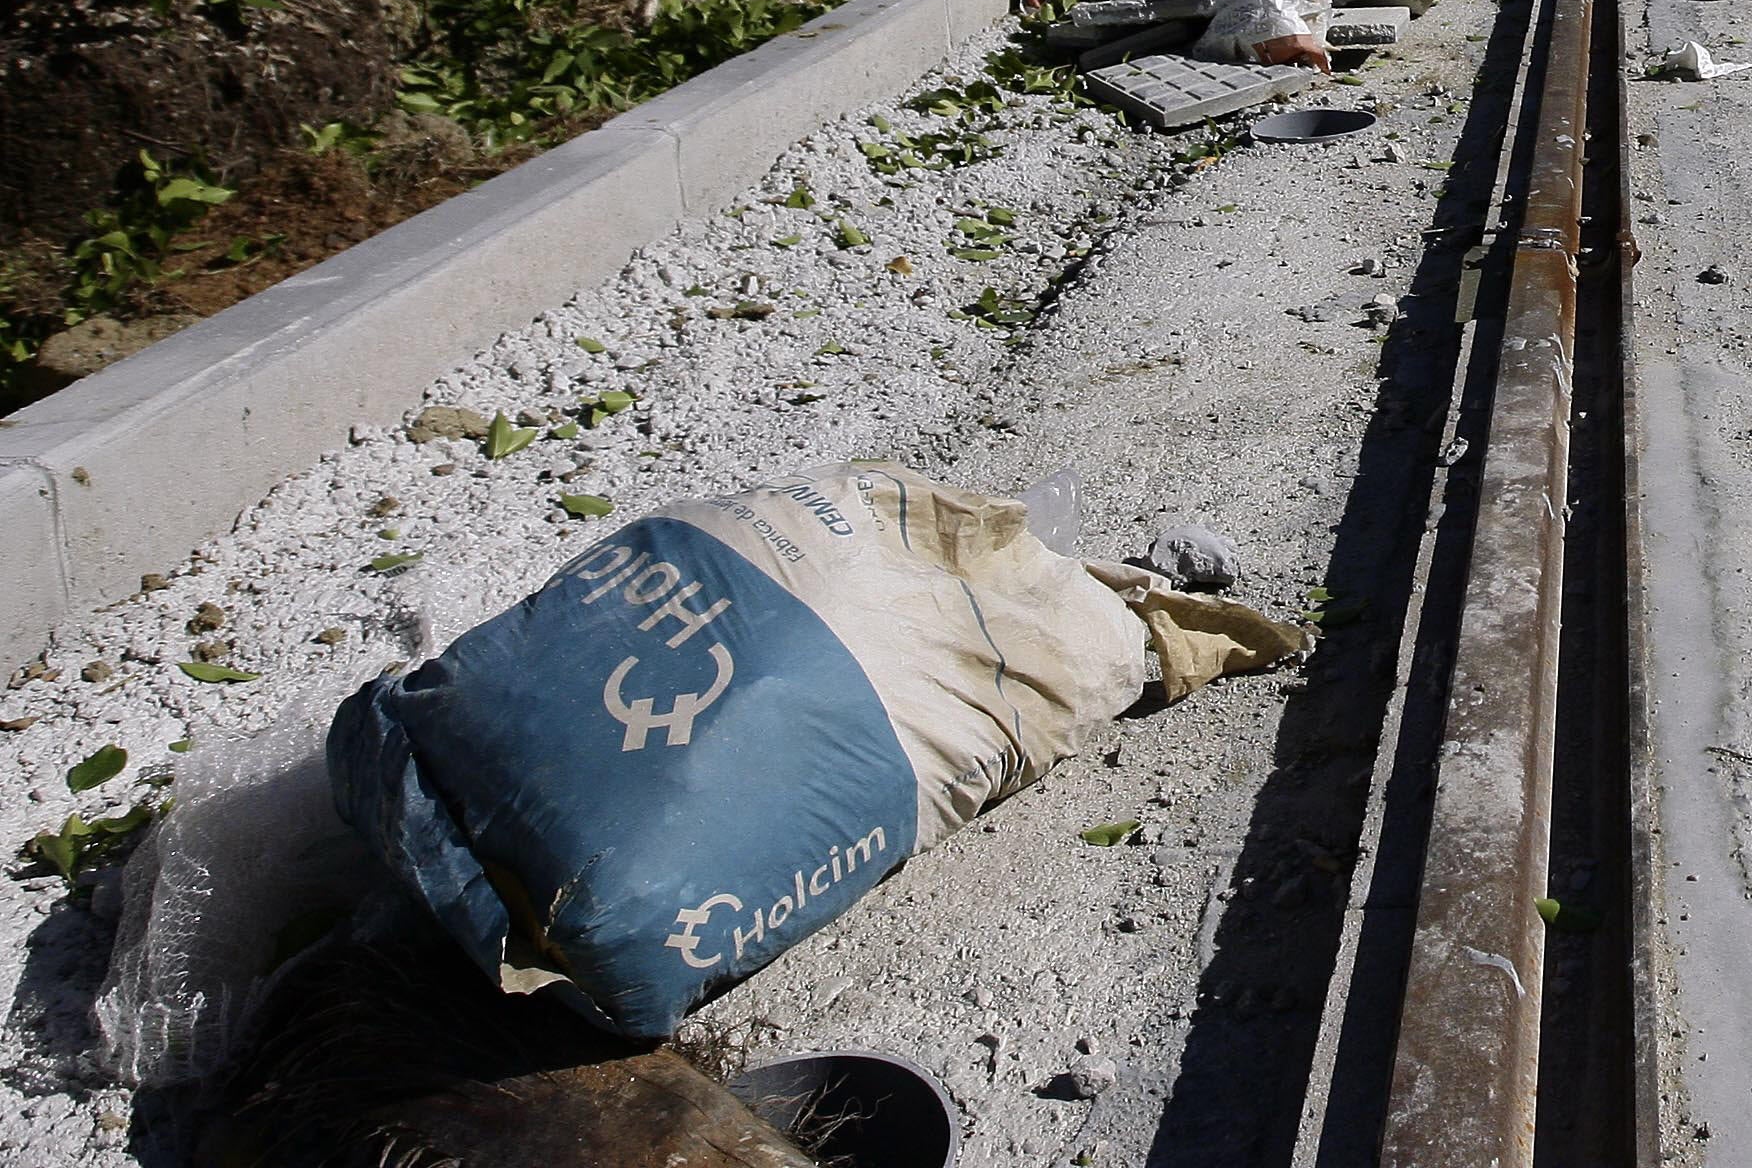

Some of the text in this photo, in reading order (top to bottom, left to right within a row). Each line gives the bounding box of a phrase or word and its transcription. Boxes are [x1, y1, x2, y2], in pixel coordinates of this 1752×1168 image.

[734, 504, 755, 520] de
[752, 519, 806, 563] Fábrica
[732, 826, 886, 961] Holcim
